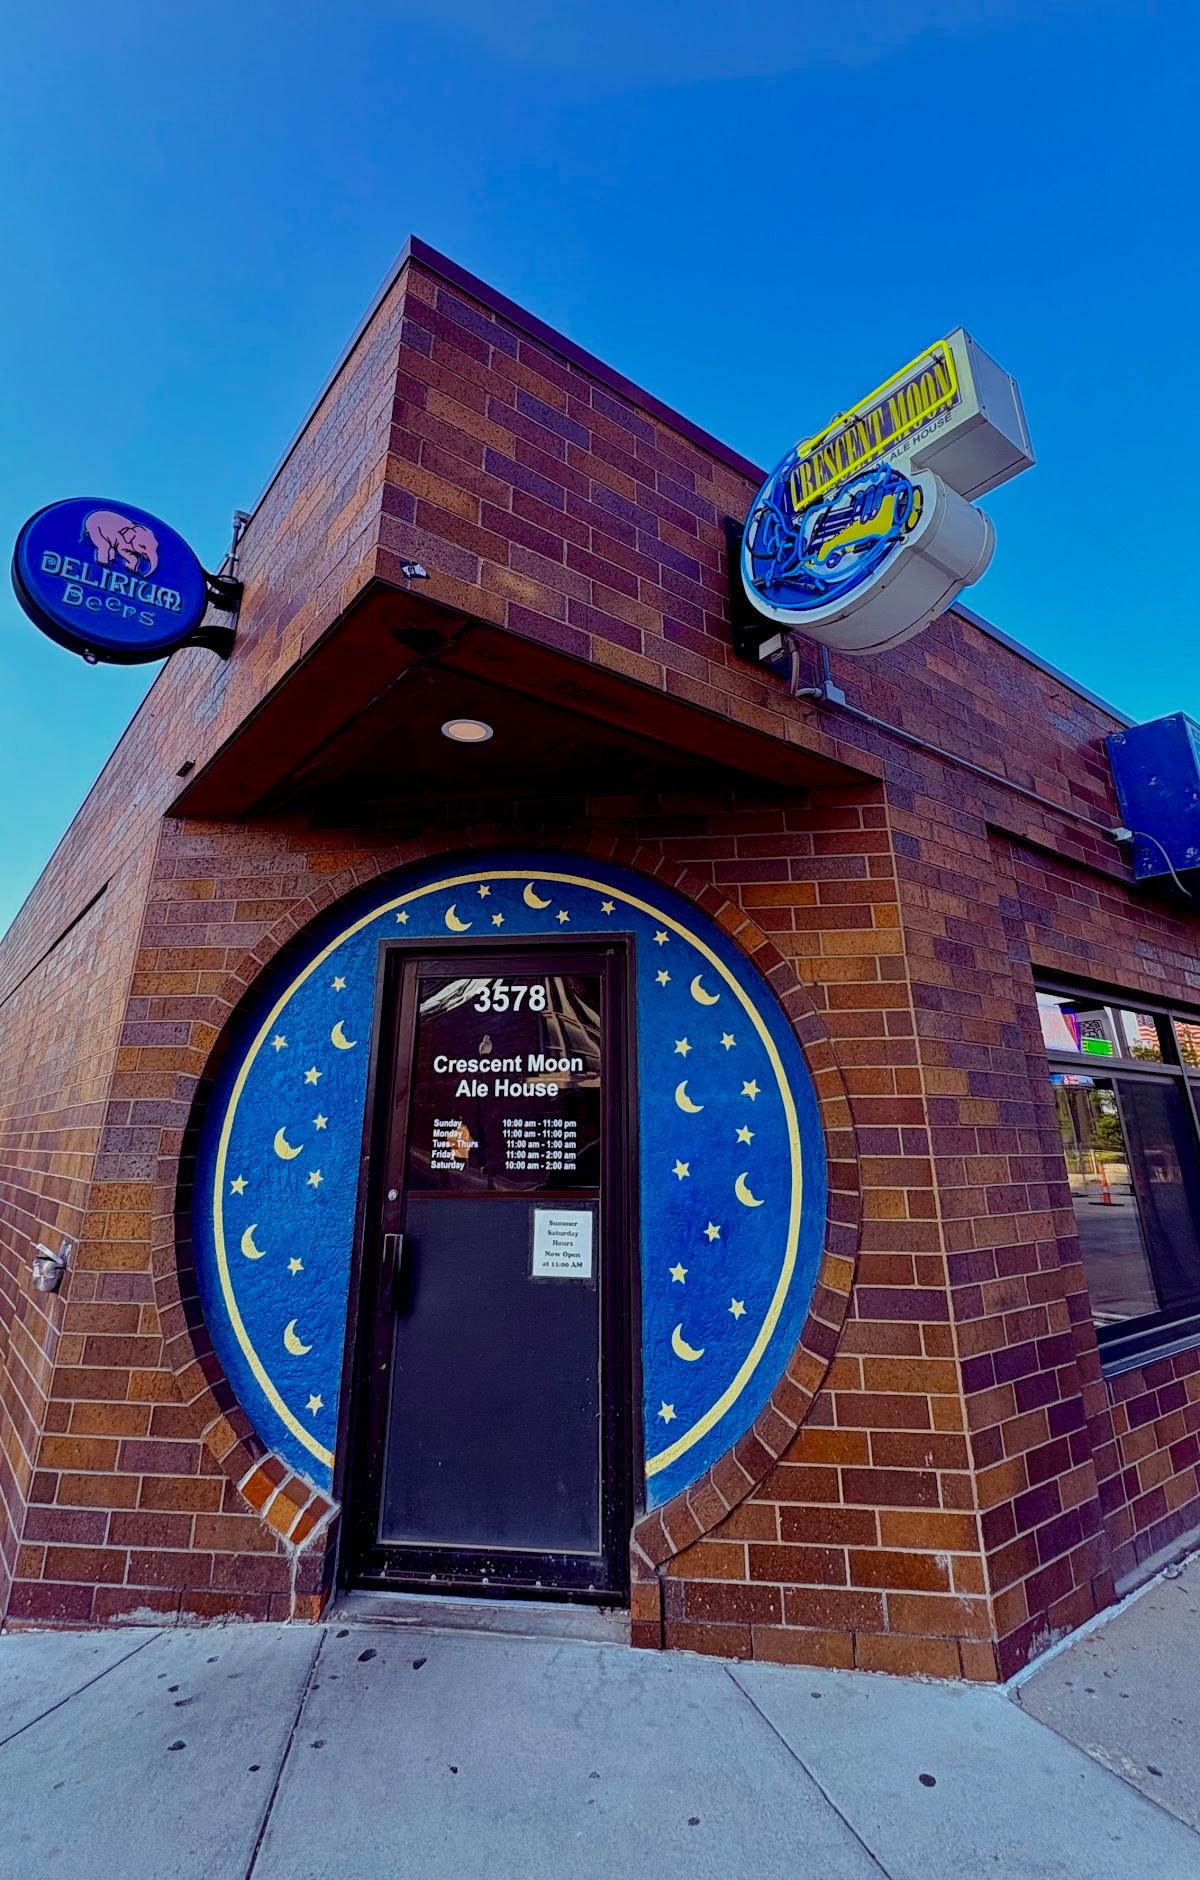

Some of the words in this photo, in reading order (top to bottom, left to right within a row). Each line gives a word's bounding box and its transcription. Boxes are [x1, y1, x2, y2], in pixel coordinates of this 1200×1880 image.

[790, 407, 886, 511] CRESCENT
[888, 361, 954, 443] MOON
[890, 443, 911, 462] ALE
[912, 412, 953, 445] HOUSE
[40, 550, 181, 612] DELIRIUM
[474, 984, 546, 1013] 3578
[433, 1055, 522, 1073] Crescent
[528, 1054, 583, 1073] Moon
[455, 1079, 488, 1097] Ale
[494, 1079, 559, 1098] House
[433, 1129, 463, 1139] Monday
[502, 1130, 523, 1138] 11:00
[543, 1130, 563, 1138] 11:00
[564, 1131, 577, 1139] pm
[434, 1119, 462, 1129] Sunday
[502, 1119, 523, 1128] 10:00
[543, 1119, 563, 1128] 11:00
[564, 1121, 577, 1130] pm
[433, 1140, 450, 1148] Tues
[457, 1140, 479, 1148] Thurs
[506, 1140, 527, 1148] 11:00
[546, 1140, 562, 1148] 1:00
[431, 1150, 456, 1160] Friday
[506, 1151, 526, 1159] 11:00
[546, 1151, 562, 1159] 2:00
[431, 1161, 465, 1171] Saturday
[505, 1161, 526, 1170] 10:00
[545, 1161, 562, 1170] 2:00
